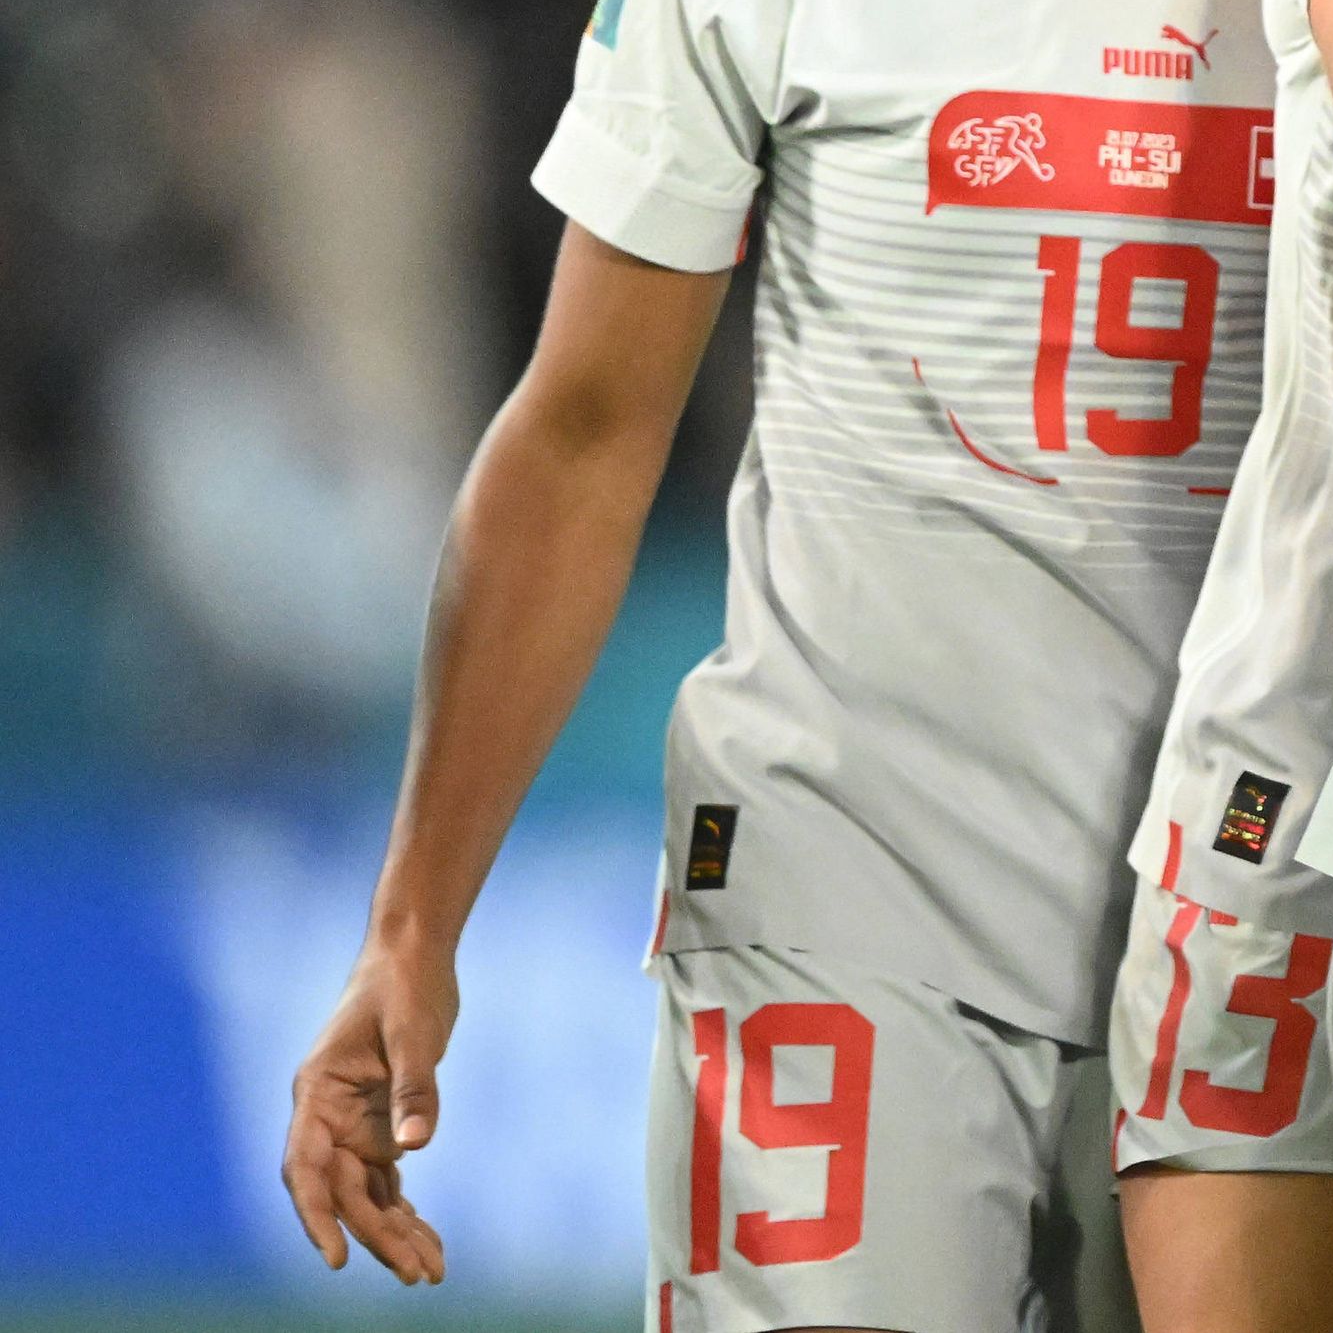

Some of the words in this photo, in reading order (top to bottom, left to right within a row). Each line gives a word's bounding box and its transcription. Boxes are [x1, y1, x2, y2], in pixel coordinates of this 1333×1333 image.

[1103, 48, 1193, 80] PUMA
[1098, 145, 1132, 169] PHI
[1148, 149, 1181, 174] SUI
[1034, 235, 1219, 457] 19
[690, 1002, 875, 1275] 19
